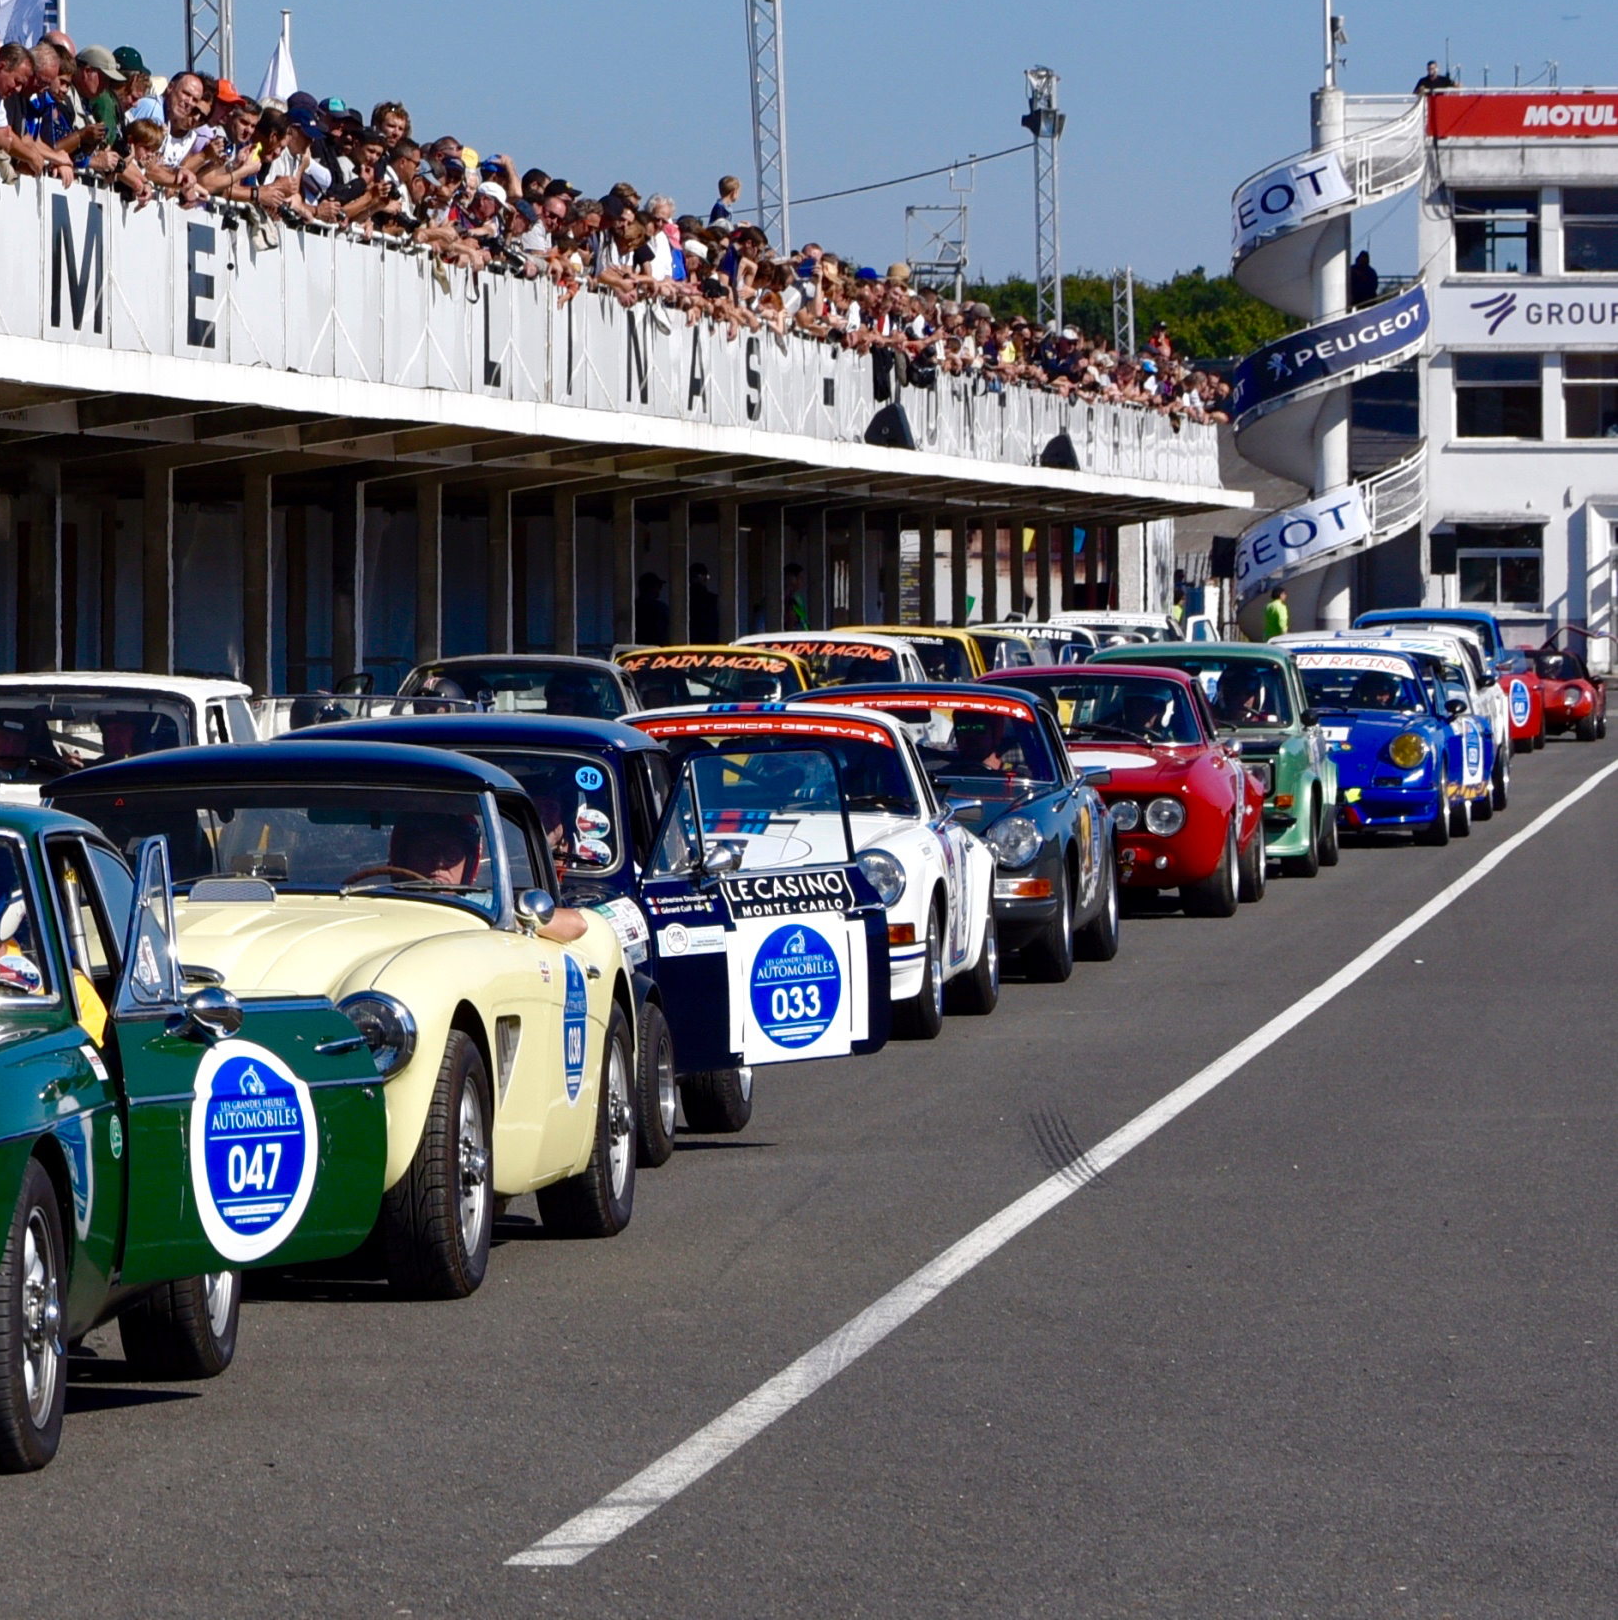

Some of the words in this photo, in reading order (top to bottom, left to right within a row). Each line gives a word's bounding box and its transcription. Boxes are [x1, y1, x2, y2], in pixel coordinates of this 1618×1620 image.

[1522, 104, 1618, 127] MOTUL
[1294, 304, 1421, 368] PEUGEOT
[820, 643, 892, 661] RACING
[650, 654, 708, 670] DAIN
[708, 655, 788, 673] RACING
[1328, 656, 1404, 671] RACING
[580, 770, 598, 785] 39
[726, 879, 754, 901] LE
[754, 872, 843, 899] CASINO
[741, 902, 791, 917] MONTE
[798, 898, 844, 912] CARLO
[756, 959, 834, 980] AUTOMOBILES
[771, 984, 821, 1021] 033
[232, 1098, 262, 1111] GRANDES
[211, 1107, 298, 1131] AUTOMOBILES
[228, 1142, 282, 1193] 047
